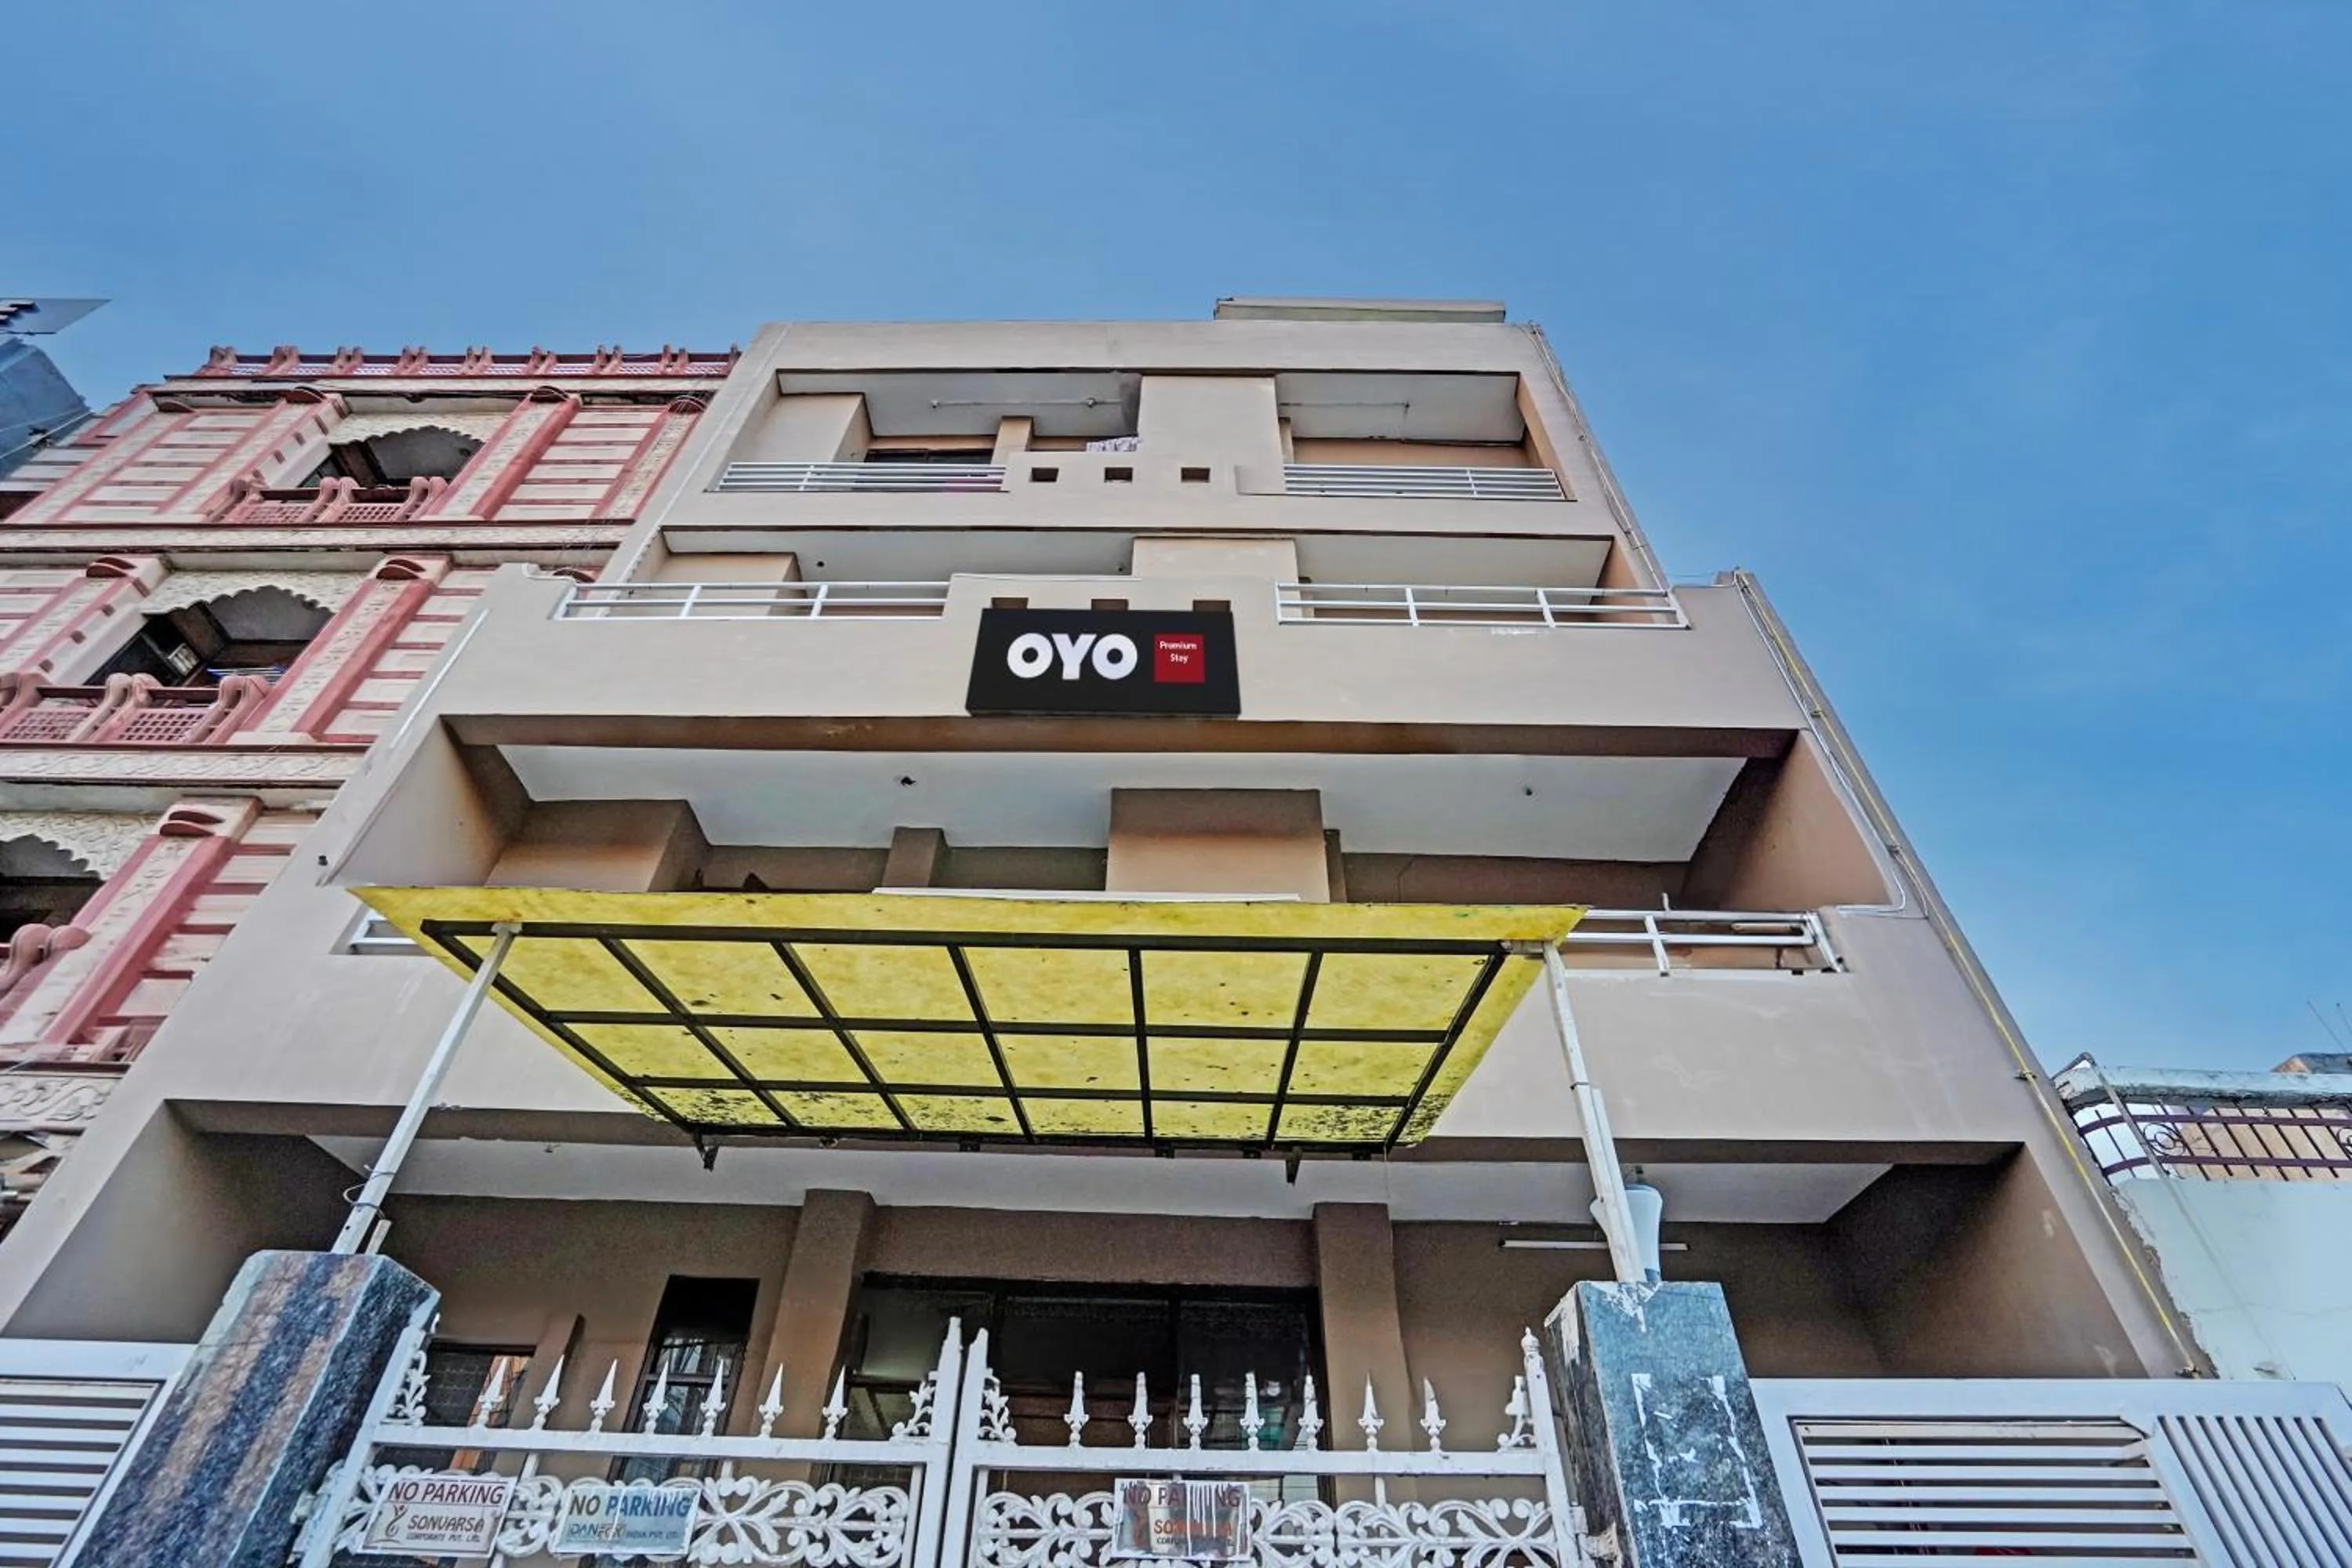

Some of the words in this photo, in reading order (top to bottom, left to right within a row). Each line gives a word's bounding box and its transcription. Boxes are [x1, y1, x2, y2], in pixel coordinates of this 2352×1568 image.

[1007, 633, 1138, 681] OYO
[1160, 641, 1197, 650] Premium
[1170, 652, 1189, 664] Stay
[389, 1481, 419, 1501] NO
[422, 1482, 506, 1504] PARKING
[569, 1494, 601, 1515] NO
[605, 1494, 692, 1517] PARKING
